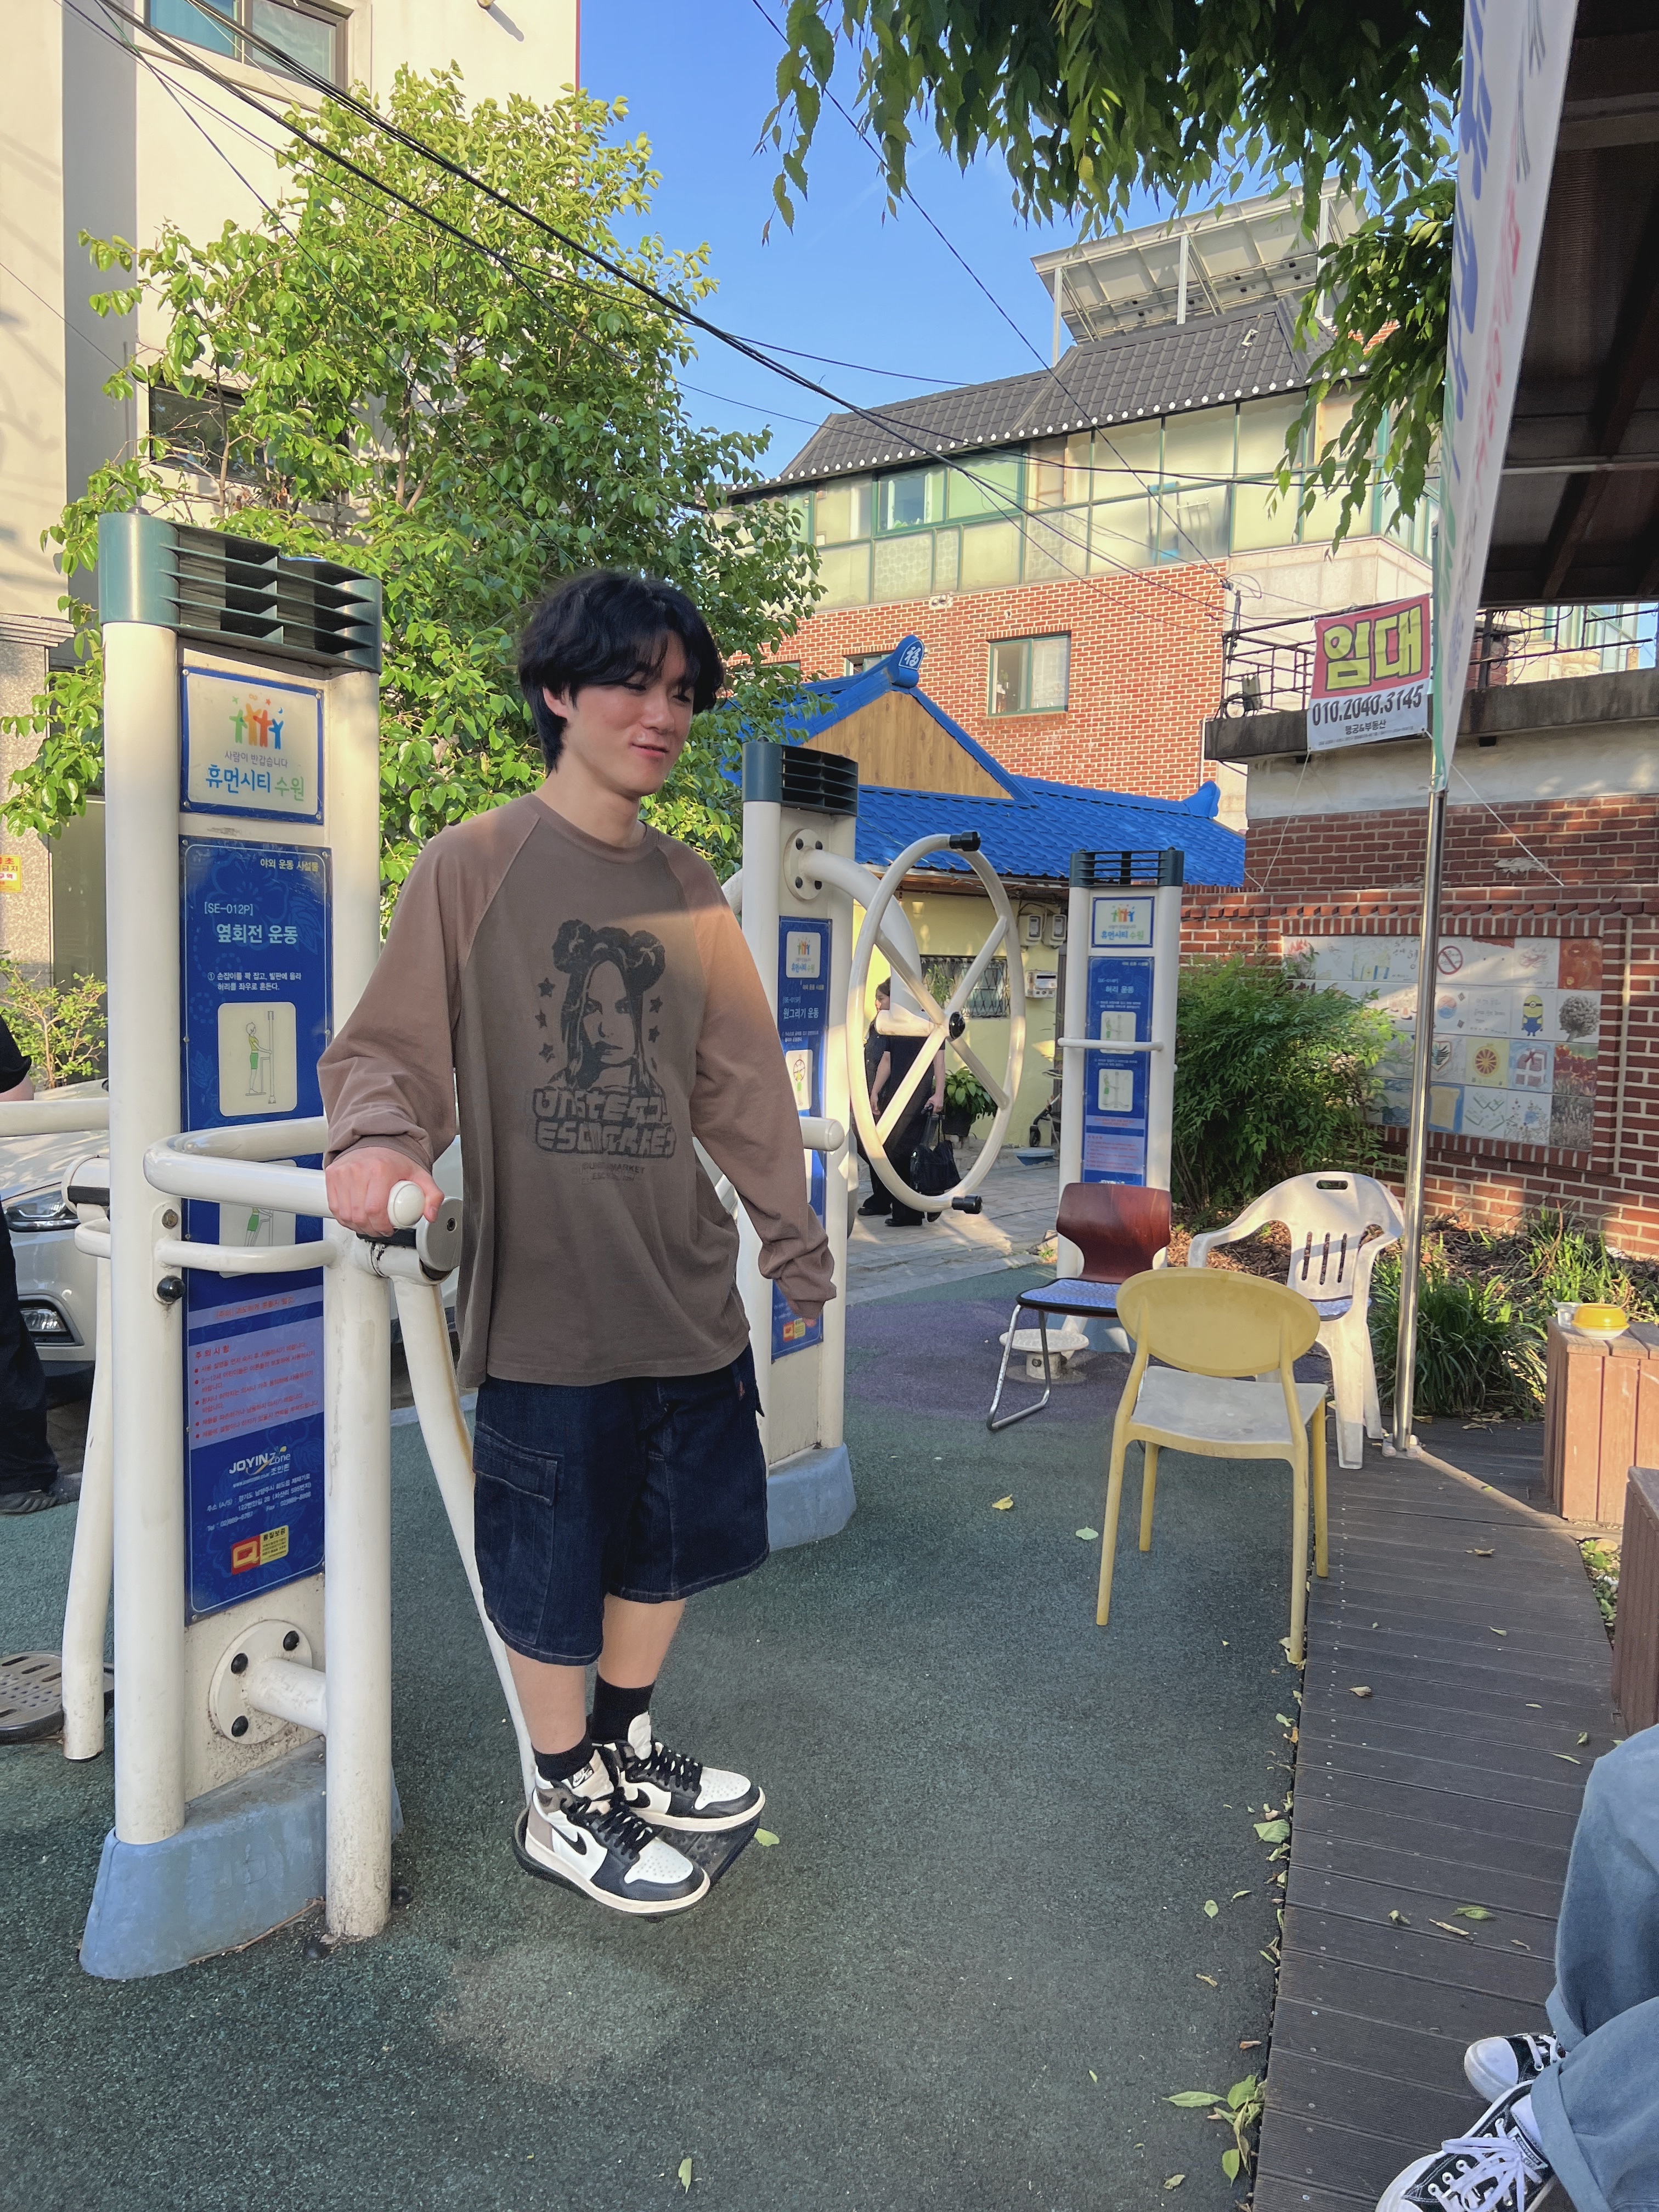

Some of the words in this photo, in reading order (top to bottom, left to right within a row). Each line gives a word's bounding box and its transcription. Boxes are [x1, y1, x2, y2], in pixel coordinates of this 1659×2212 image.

[1323, 603, 1423, 692] 임대
[905, 646, 922, 667] 福
[1312, 684, 1424, 726] 010.2040.3145
[224, 750, 248, 763] 사람이
[251, 752, 288, 768] 반갑습니다
[206, 764, 271, 793] 휴먼시티
[274, 776, 304, 802] 수원
[260, 858, 276, 868] 야외
[279, 859, 294, 870] 운동
[296, 862, 319, 872] 시설물
[204, 902, 253, 916] [SE-012P]
[216, 924, 262, 944] 옆회전
[268, 925, 298, 944] 운동
[1101, 930, 1128, 940] 휴먼시티
[1130, 930, 1144, 940] 수원
[217, 972, 242, 980] 손잡이를
[217, 983, 236, 991] 허리를
[239, 983, 258, 991] 좌우로
[783, 1008, 806, 1020] 원그리기
[808, 1008, 819, 1018] 운동
